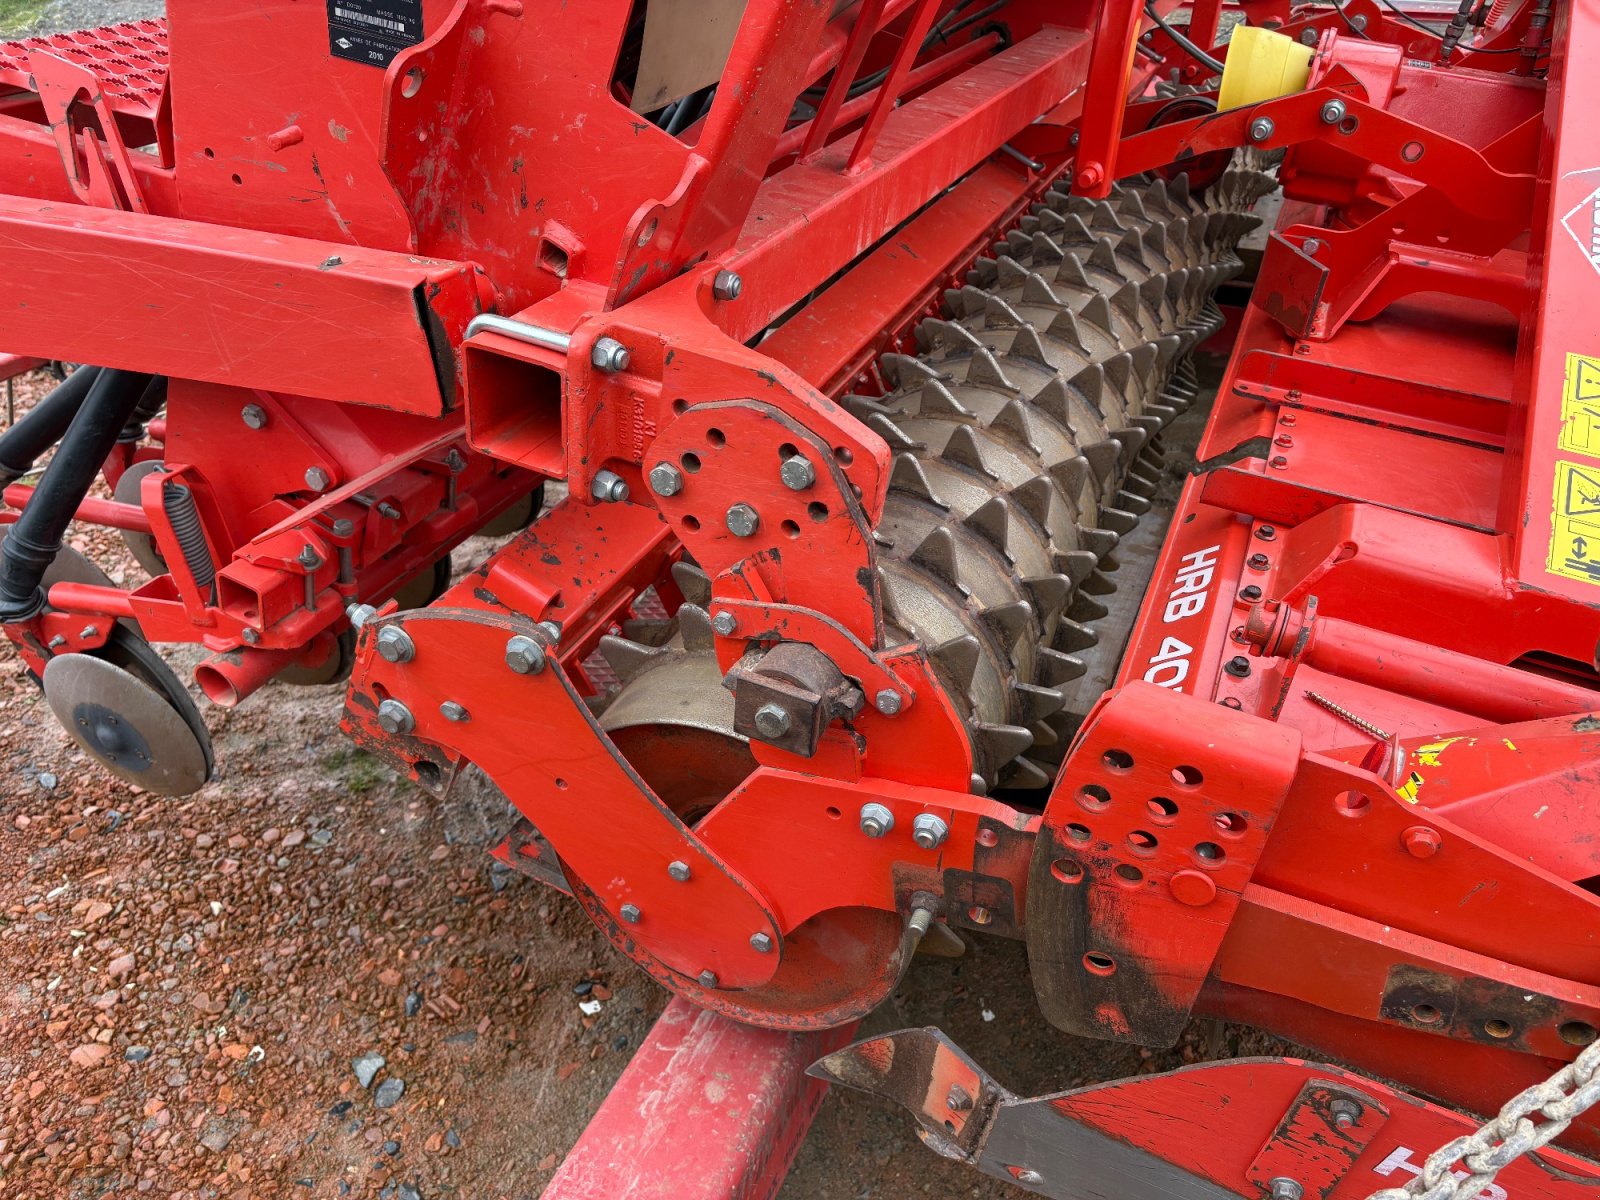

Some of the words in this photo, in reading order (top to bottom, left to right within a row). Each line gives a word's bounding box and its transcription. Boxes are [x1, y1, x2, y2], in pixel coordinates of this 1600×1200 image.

[368, 50, 384, 61] 2010
[1163, 544, 1220, 623] HRB
[1143, 636, 1194, 693] 40
